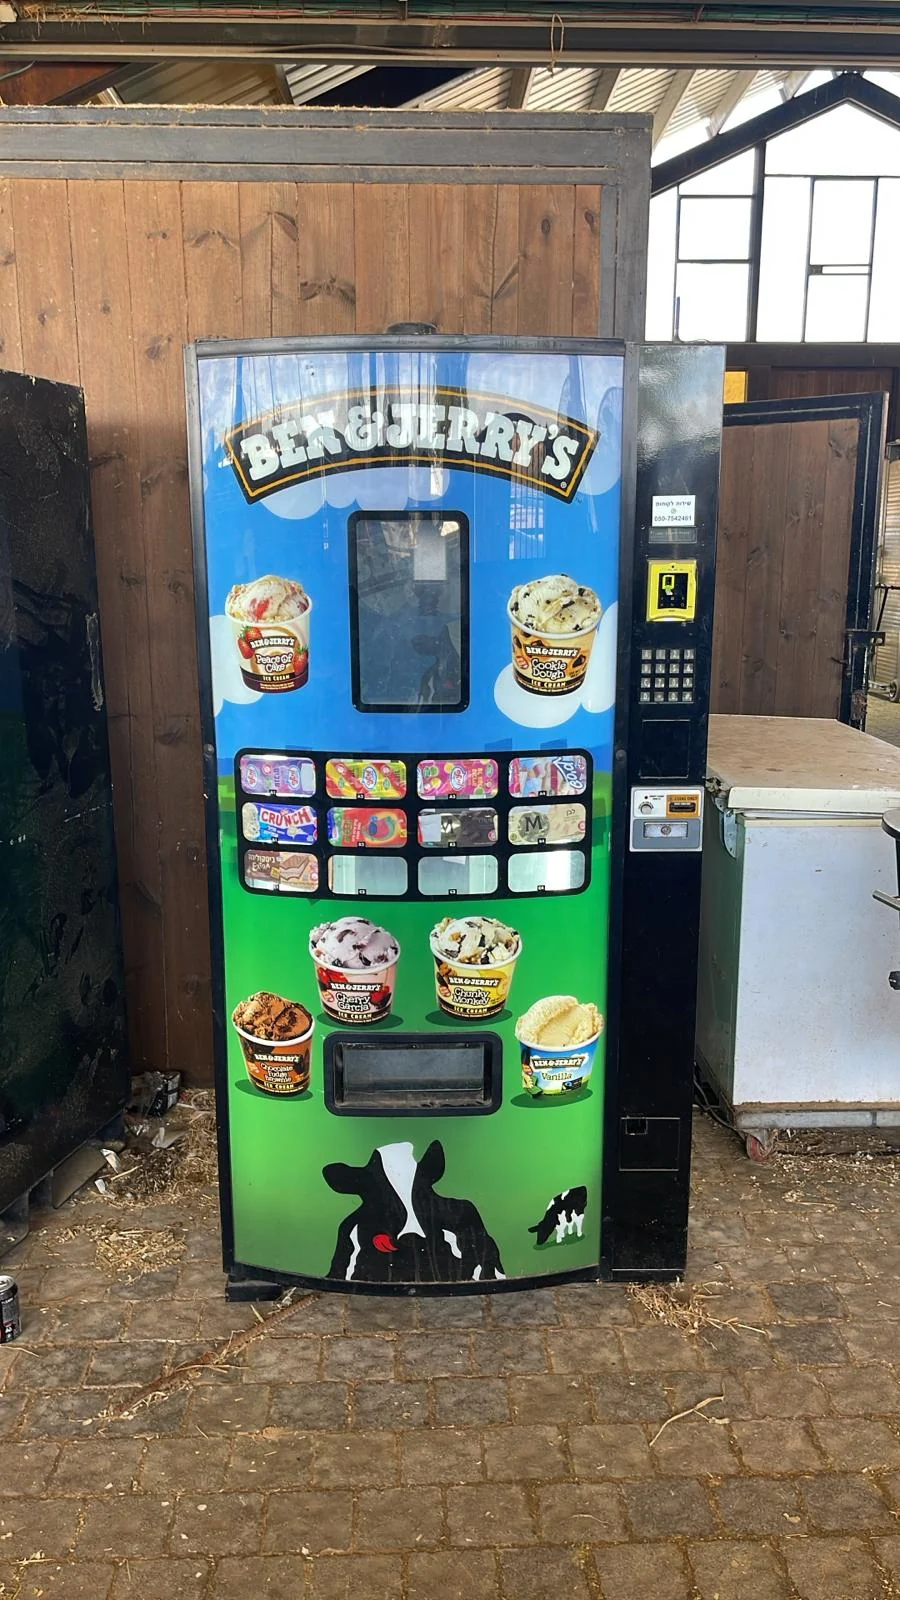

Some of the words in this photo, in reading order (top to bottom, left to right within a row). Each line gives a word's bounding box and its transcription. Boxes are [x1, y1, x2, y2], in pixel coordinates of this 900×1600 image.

[531, 659, 567, 671] Cookie
[533, 668, 566, 680] Dough
[261, 807, 311, 827] CRUNCH
[525, 815, 542, 832] M
[336, 992, 371, 1004] Cherry
[454, 987, 490, 998] Chunky
[338, 1002, 369, 1011] Garcia
[453, 996, 490, 1006] Monkey
[541, 1072, 573, 1080] Vanilla
